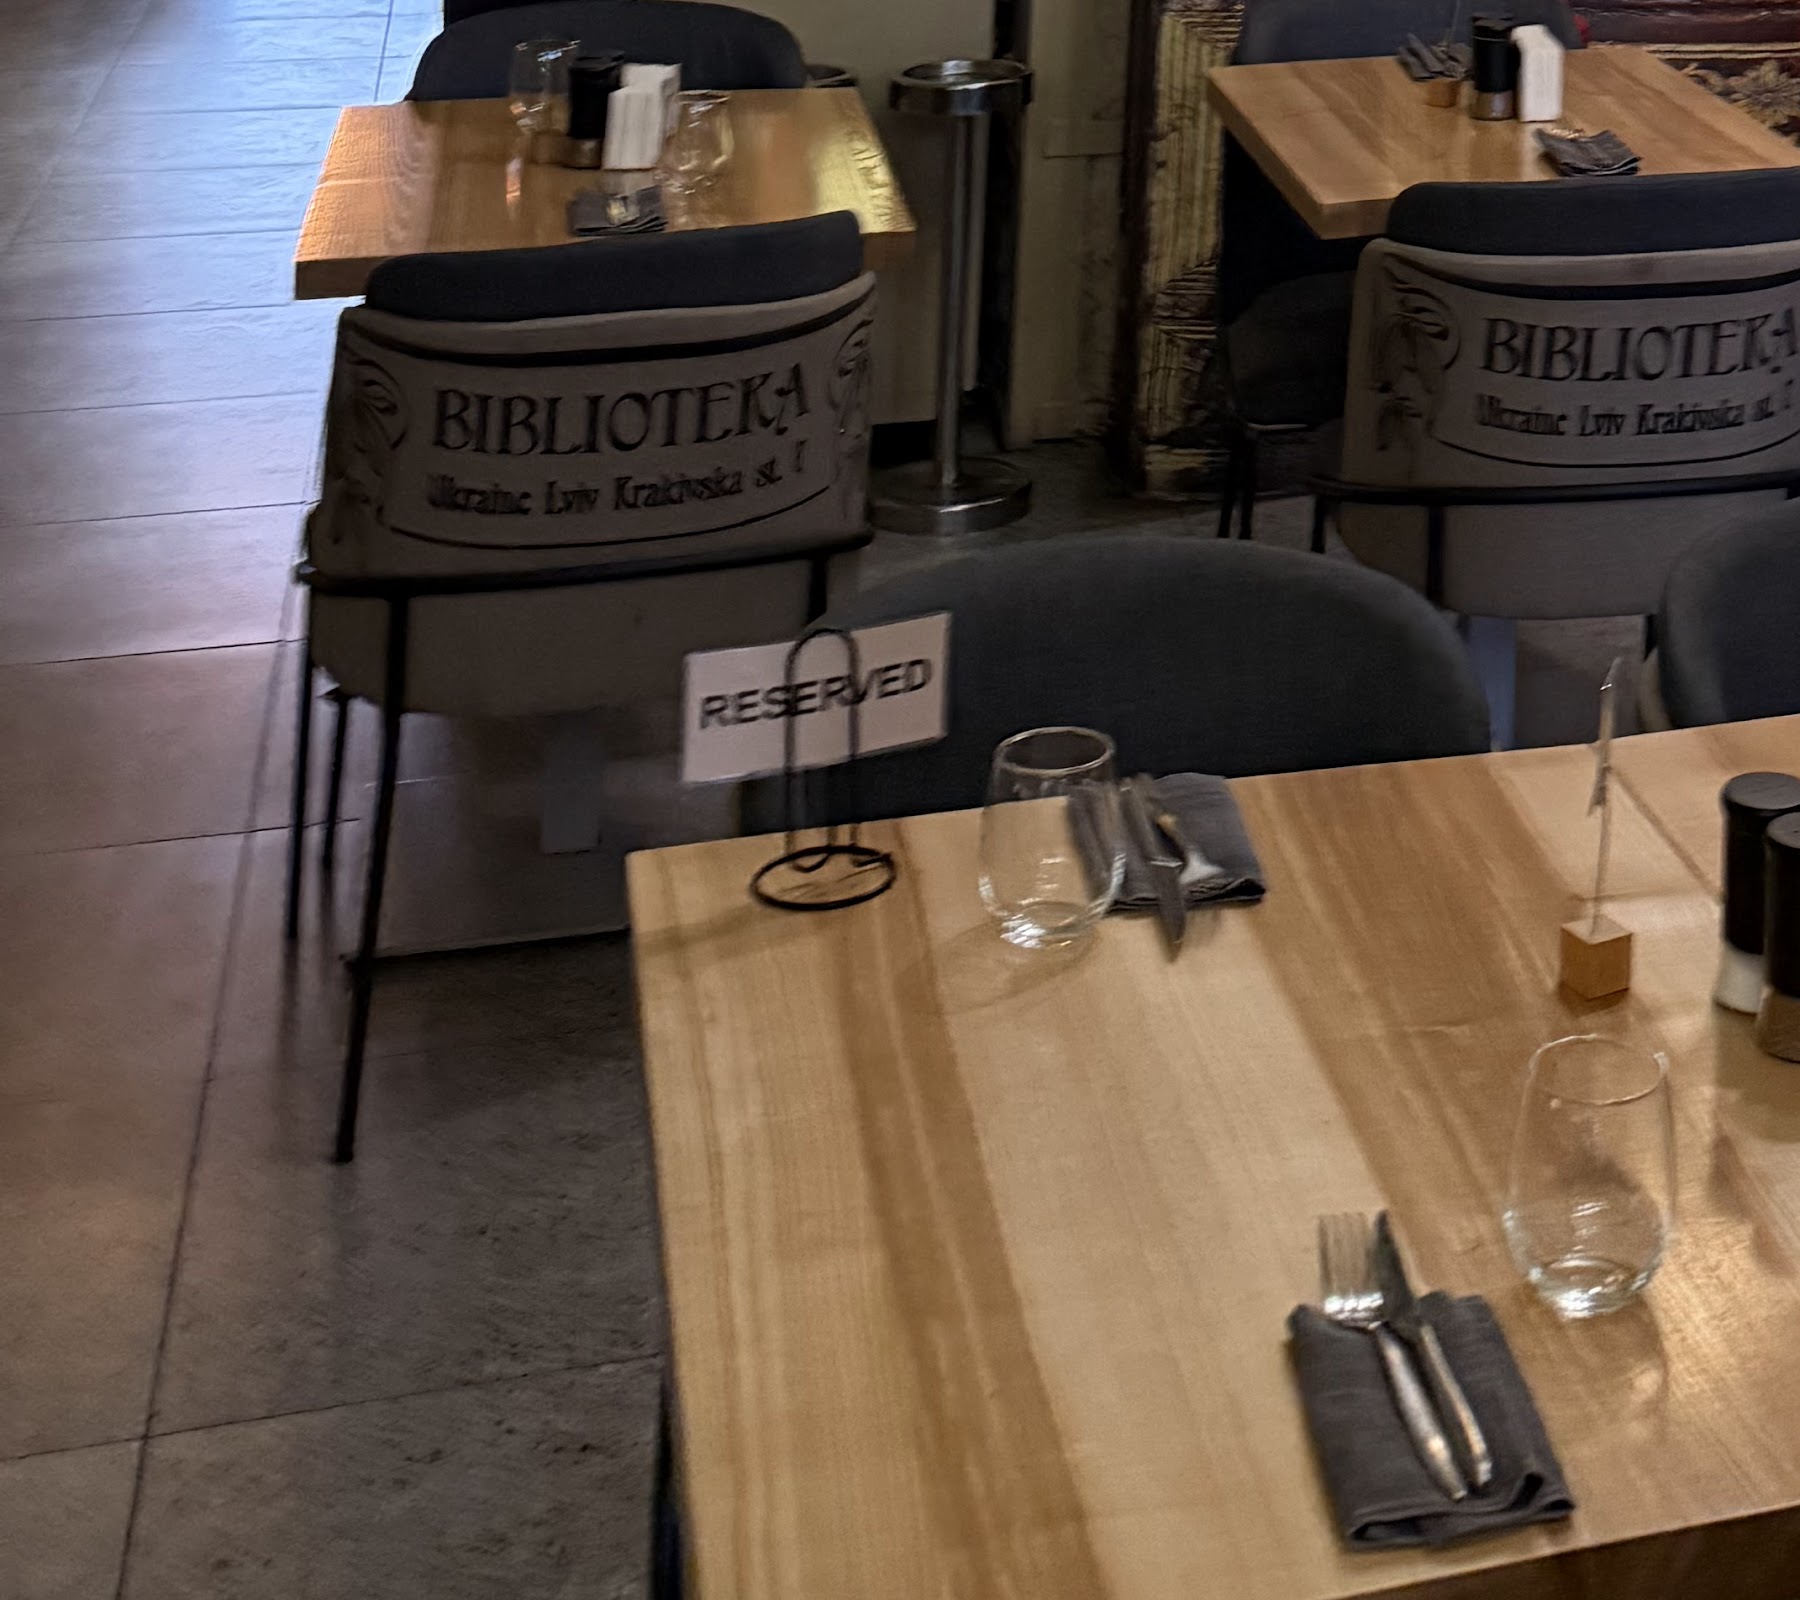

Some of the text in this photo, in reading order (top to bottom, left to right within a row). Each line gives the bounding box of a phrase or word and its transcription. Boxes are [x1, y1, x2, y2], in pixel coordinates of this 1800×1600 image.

[1480, 306, 1798, 382] BIBLIOTEKA
[432, 362, 810, 456] BIBLIOTEKA
[1578, 404, 1626, 437] Lviv
[544, 479, 600, 515] Lviv
[700, 658, 933, 730] RESERVED
